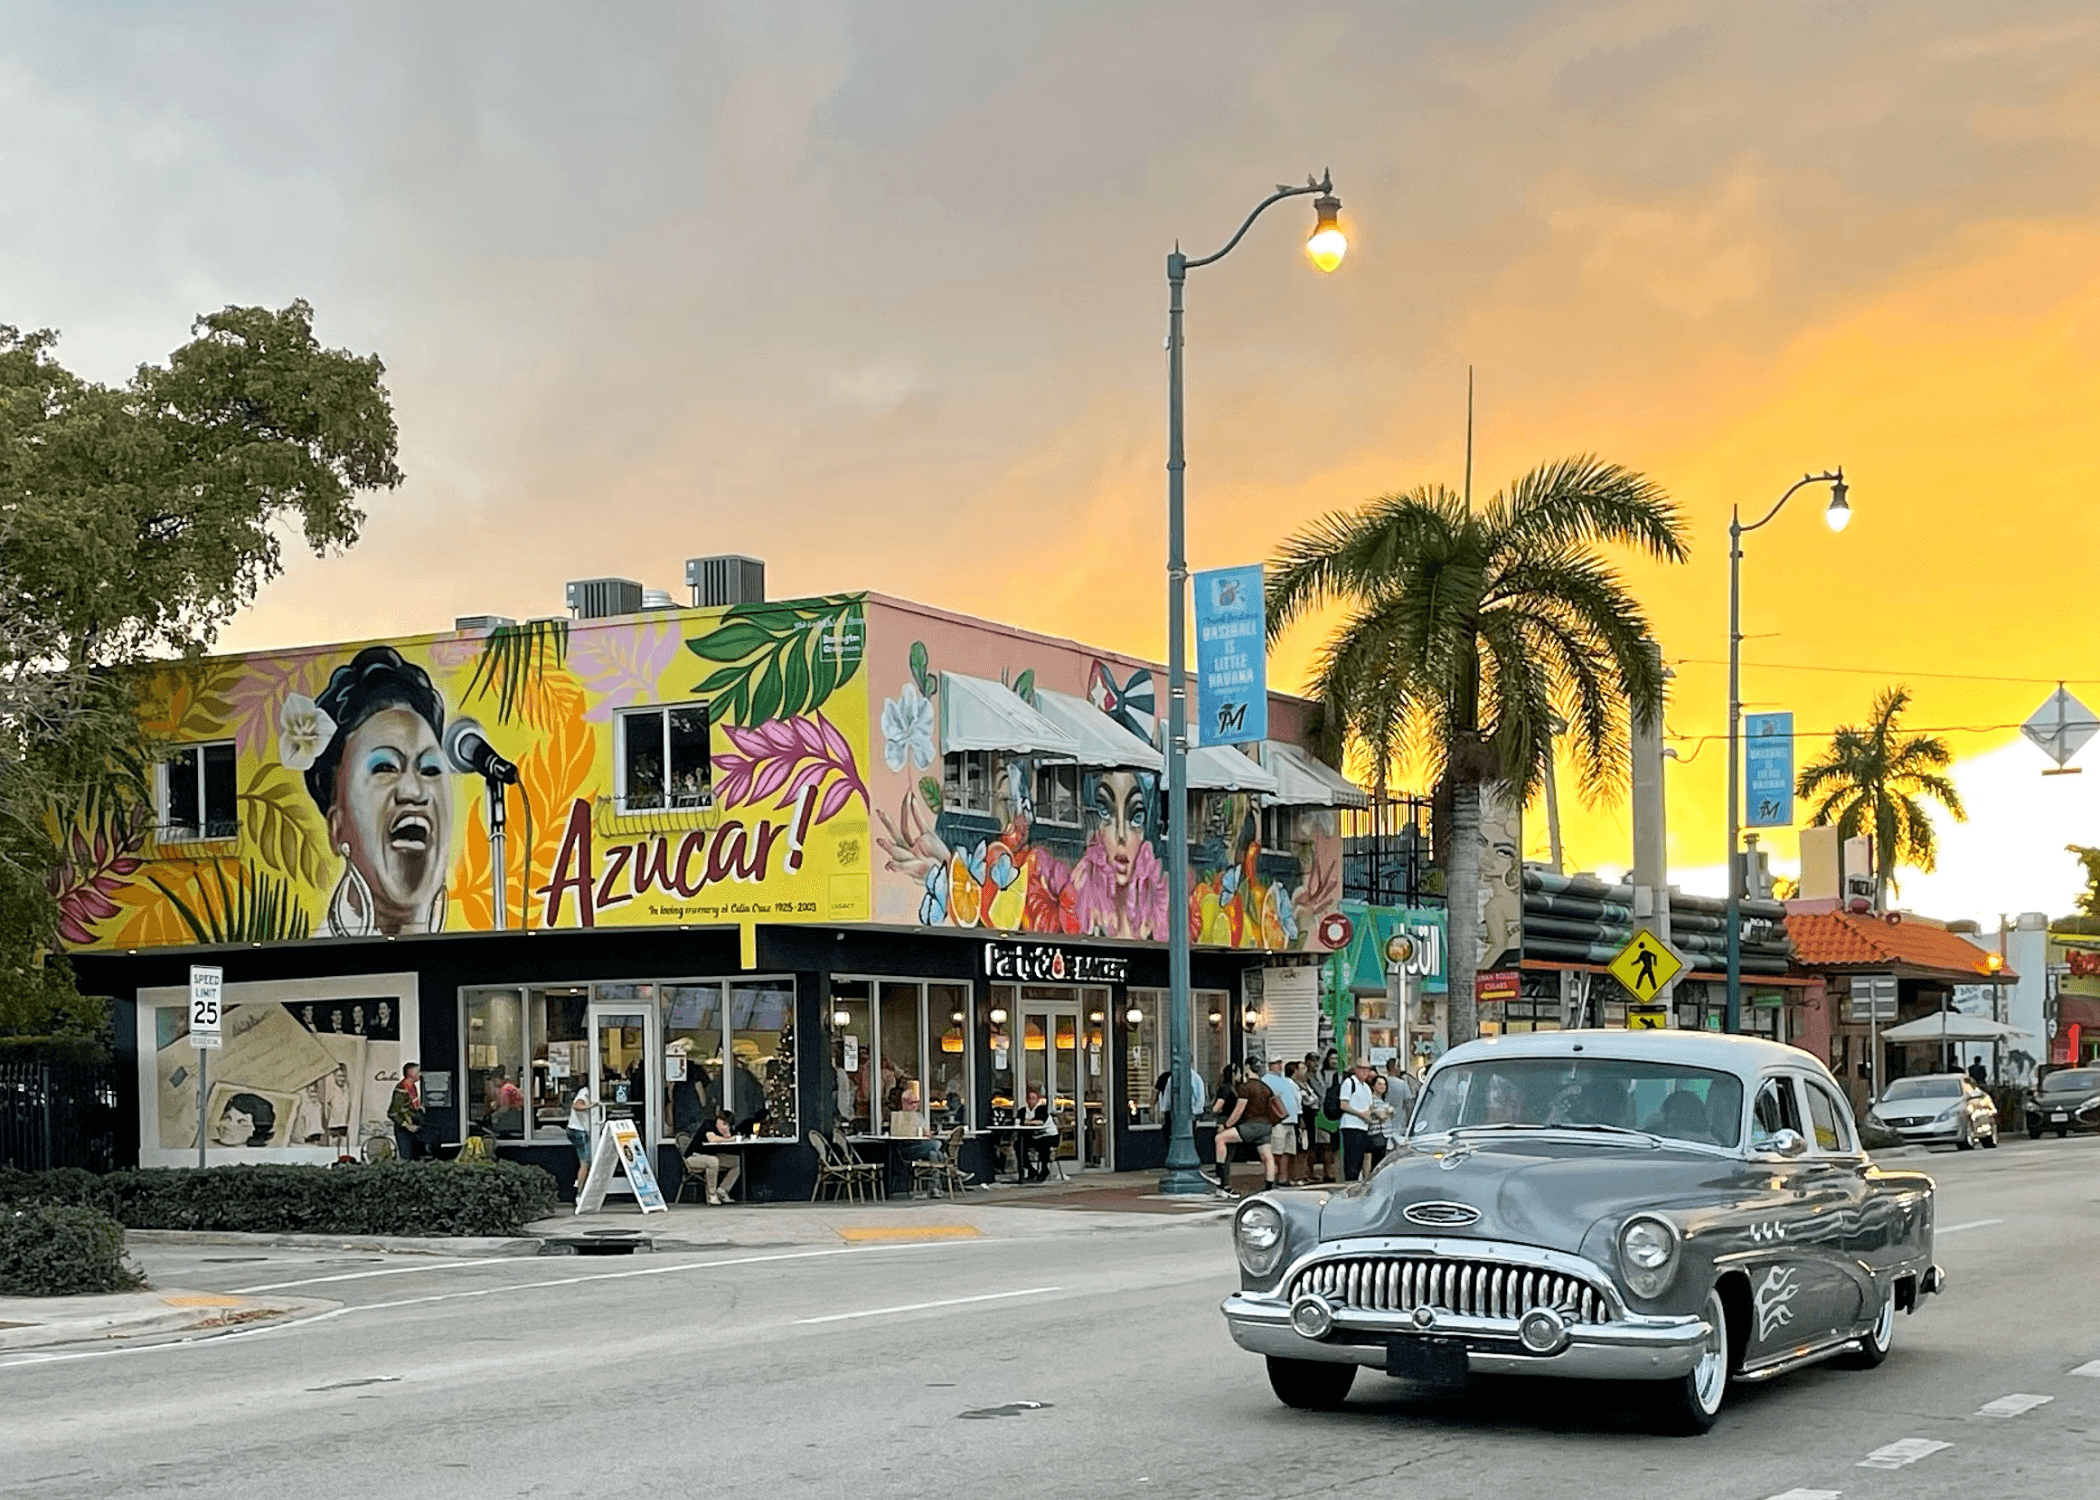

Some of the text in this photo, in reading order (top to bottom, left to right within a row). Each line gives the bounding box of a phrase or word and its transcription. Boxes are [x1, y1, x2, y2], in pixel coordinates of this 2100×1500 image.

[1202, 621, 1257, 641] BASEBALL
[1225, 639, 1236, 654] IS
[1214, 654, 1247, 672] LITTLE
[1208, 668, 1254, 688] HAVANA
[660, 905, 684, 919] loving
[193, 973, 220, 986] SPEED
[195, 988, 217, 998] LIMIT
[194, 1001, 217, 1025] 25
